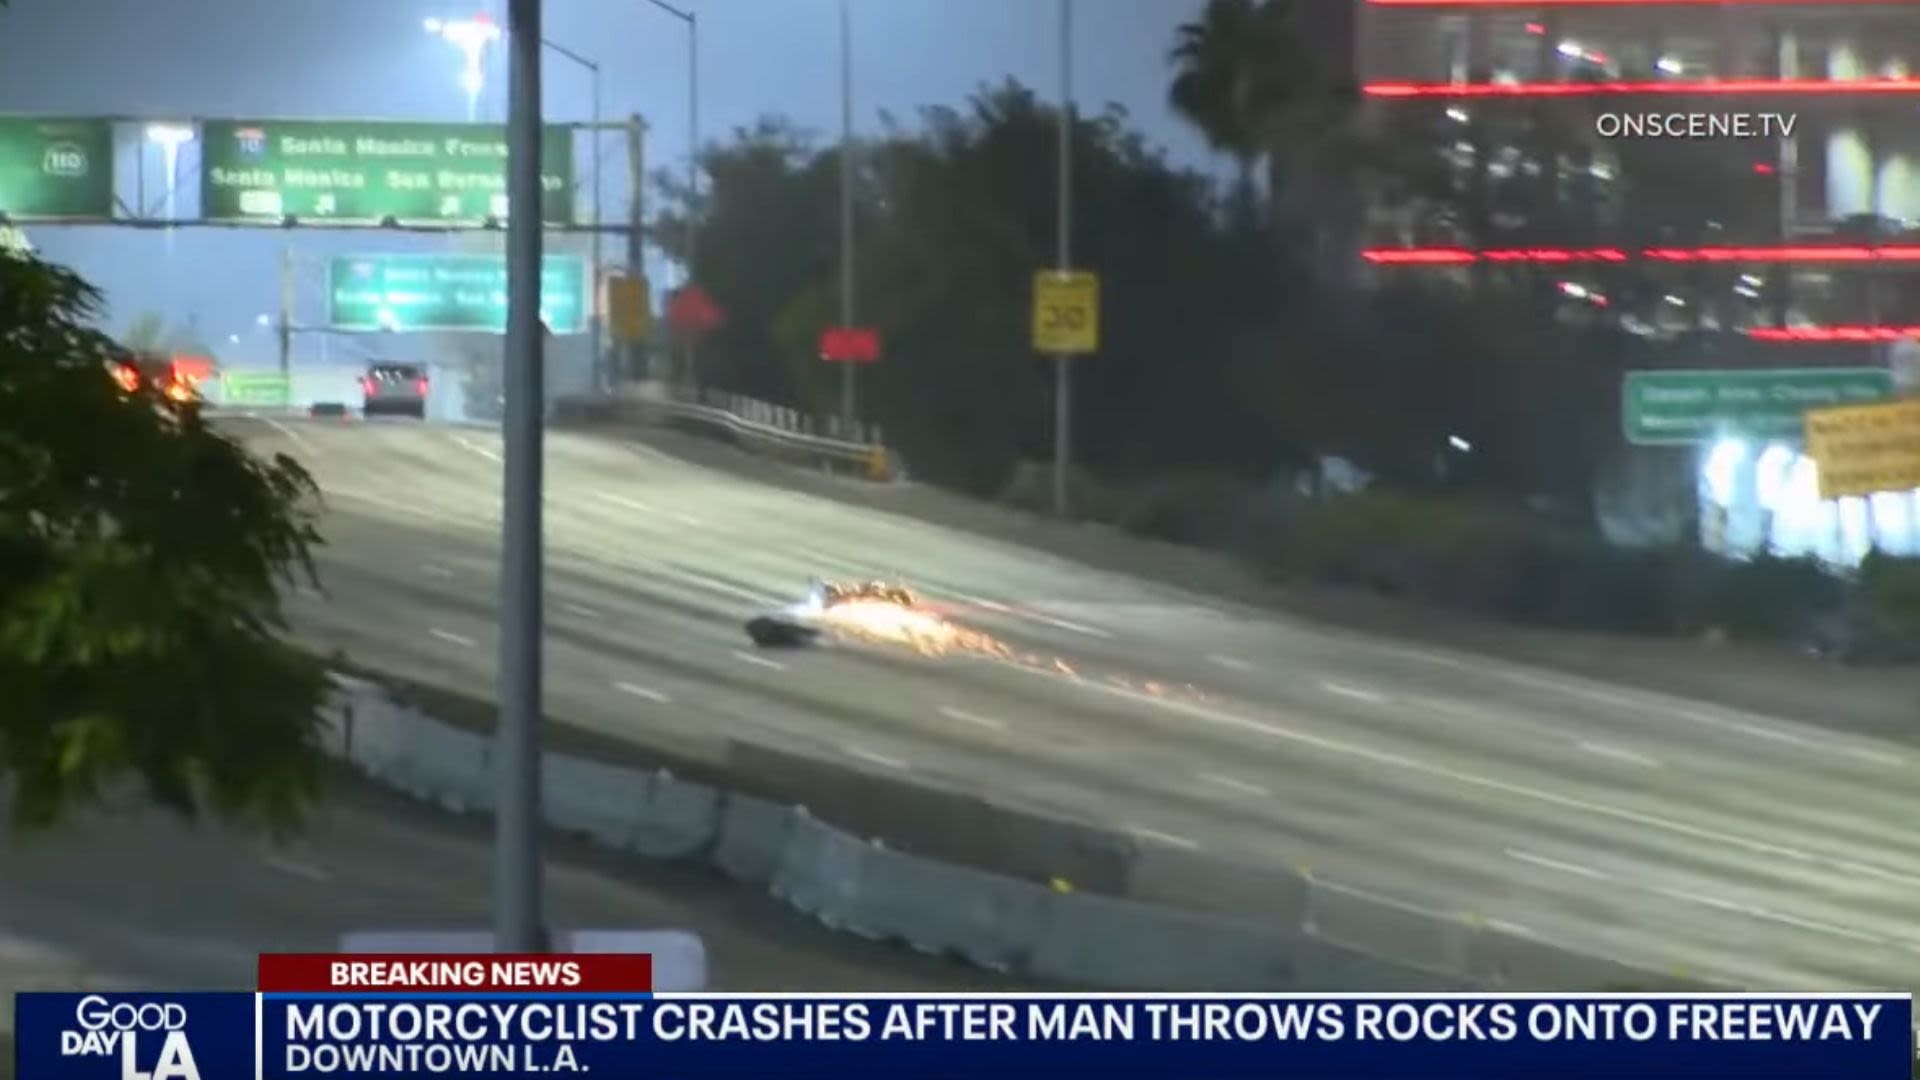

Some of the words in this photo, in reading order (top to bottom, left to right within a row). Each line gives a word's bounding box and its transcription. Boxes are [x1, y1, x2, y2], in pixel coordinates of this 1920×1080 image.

[281, 137, 346, 154] Santa
[210, 168, 275, 186] Santa
[284, 169, 364, 187] Monica
